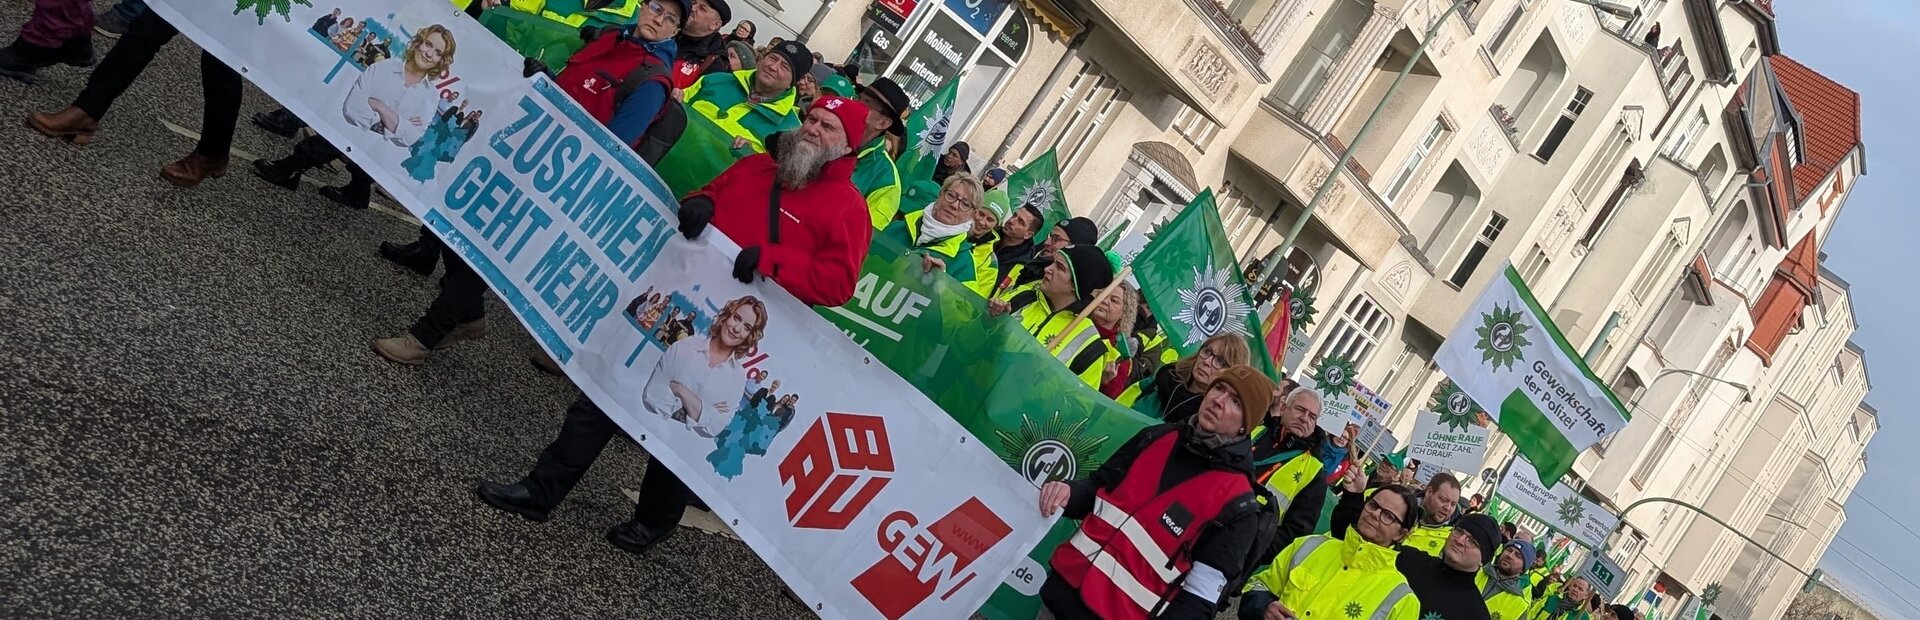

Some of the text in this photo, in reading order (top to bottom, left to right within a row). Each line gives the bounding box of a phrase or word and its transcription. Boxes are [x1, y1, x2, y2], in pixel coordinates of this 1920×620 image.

[872, 30, 890, 50] Gas
[924, 29, 963, 67] Mobilfunk
[999, 31, 1018, 50] reenet
[909, 57, 943, 88] Internet
[489, 95, 678, 284] ZUSAMMEN
[444, 155, 623, 346] GEHT MEHR
[852, 272, 931, 325] AUF
[1328, 399, 1350, 411] RAUF
[1524, 373, 1578, 431] der Polizei
[1532, 359, 1607, 438] Gewerkschaft
[1411, 447, 1425, 455] ICH
[1424, 440, 1452, 451] SONST
[1427, 430, 1484, 444] LÖHNE RAUF
[1512, 471, 1558, 502] Bezirksgruppe
[1515, 482, 1547, 506] Lüneburg
[1161, 511, 1184, 537] ver.di
[876, 509, 977, 601] GEW
[1593, 564, 1611, 588] 1:1
